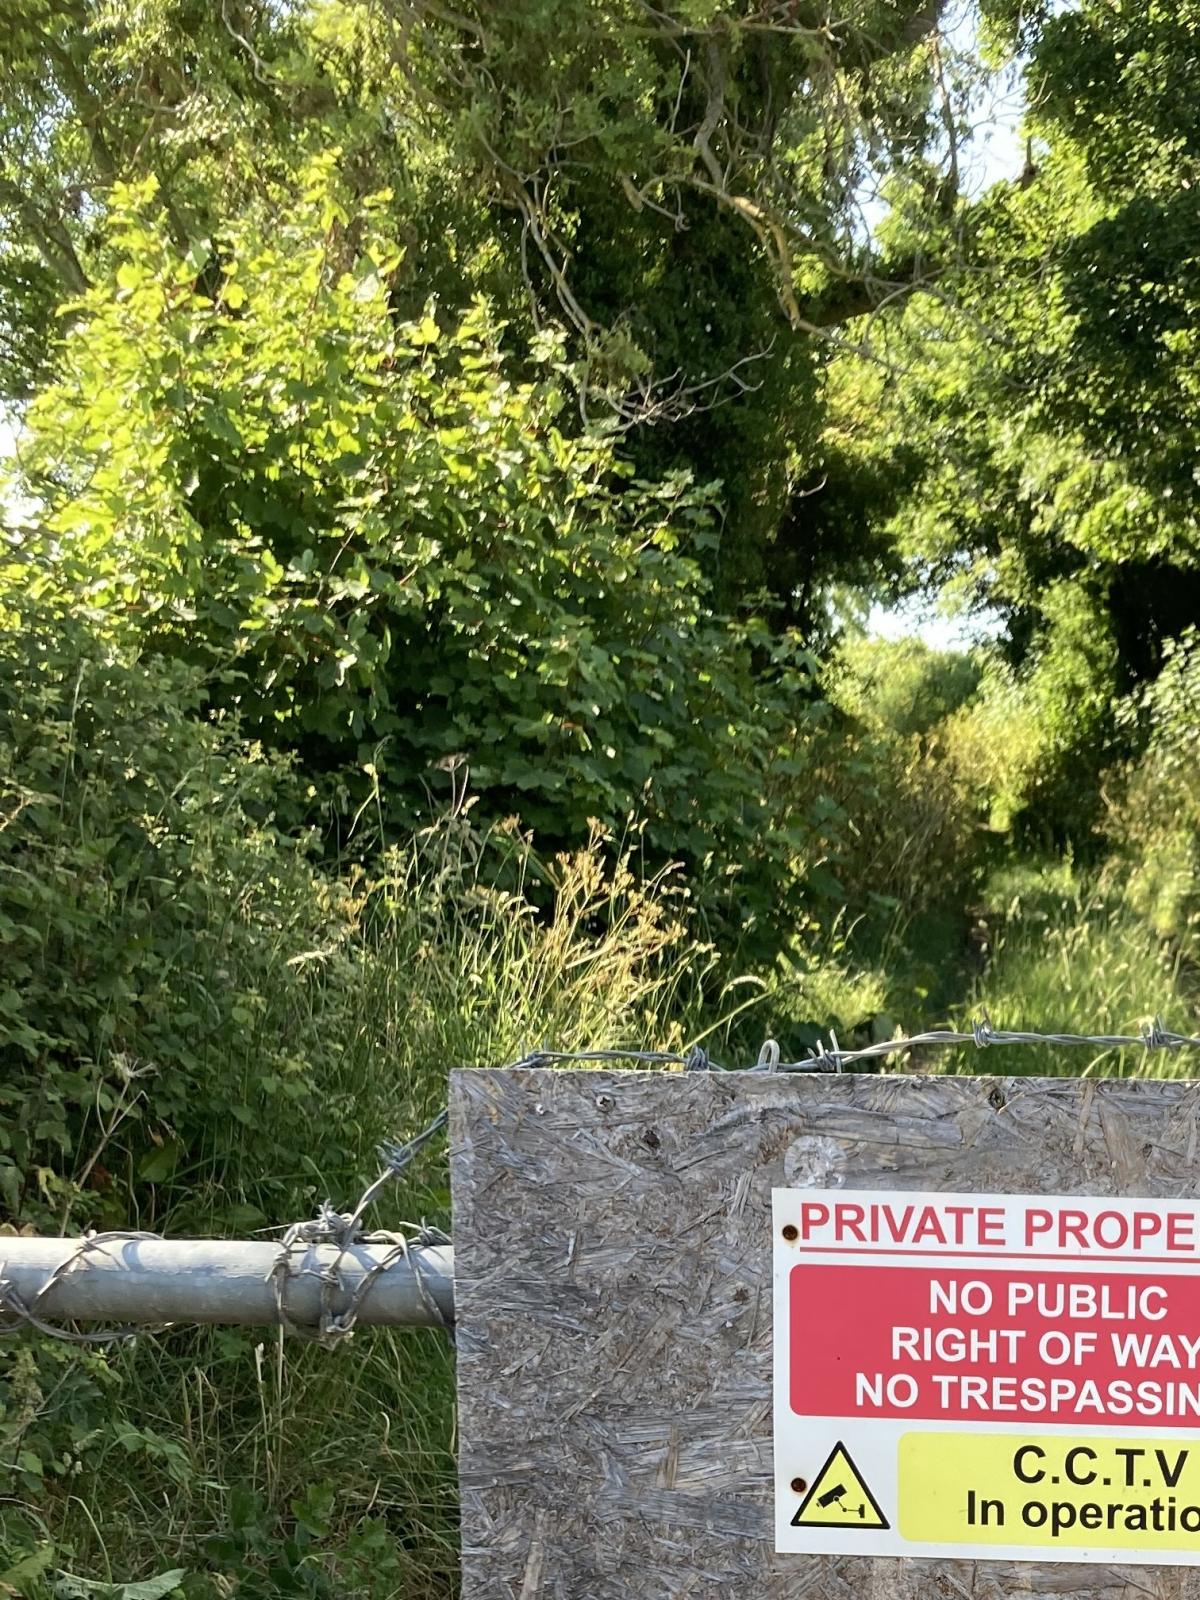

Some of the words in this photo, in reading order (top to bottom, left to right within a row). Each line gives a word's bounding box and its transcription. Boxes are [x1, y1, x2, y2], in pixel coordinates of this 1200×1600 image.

[801, 1202, 1005, 1246] PRIVATE
[930, 1279, 993, 1316] NO
[1008, 1282, 1168, 1321] PUBLIC
[892, 1326, 1026, 1364] RIGHT
[1038, 1330, 1098, 1366] OF
[856, 1372, 919, 1408] NO
[1013, 1444, 1189, 1488] C.C.T.V
[967, 1490, 1005, 1526] In
